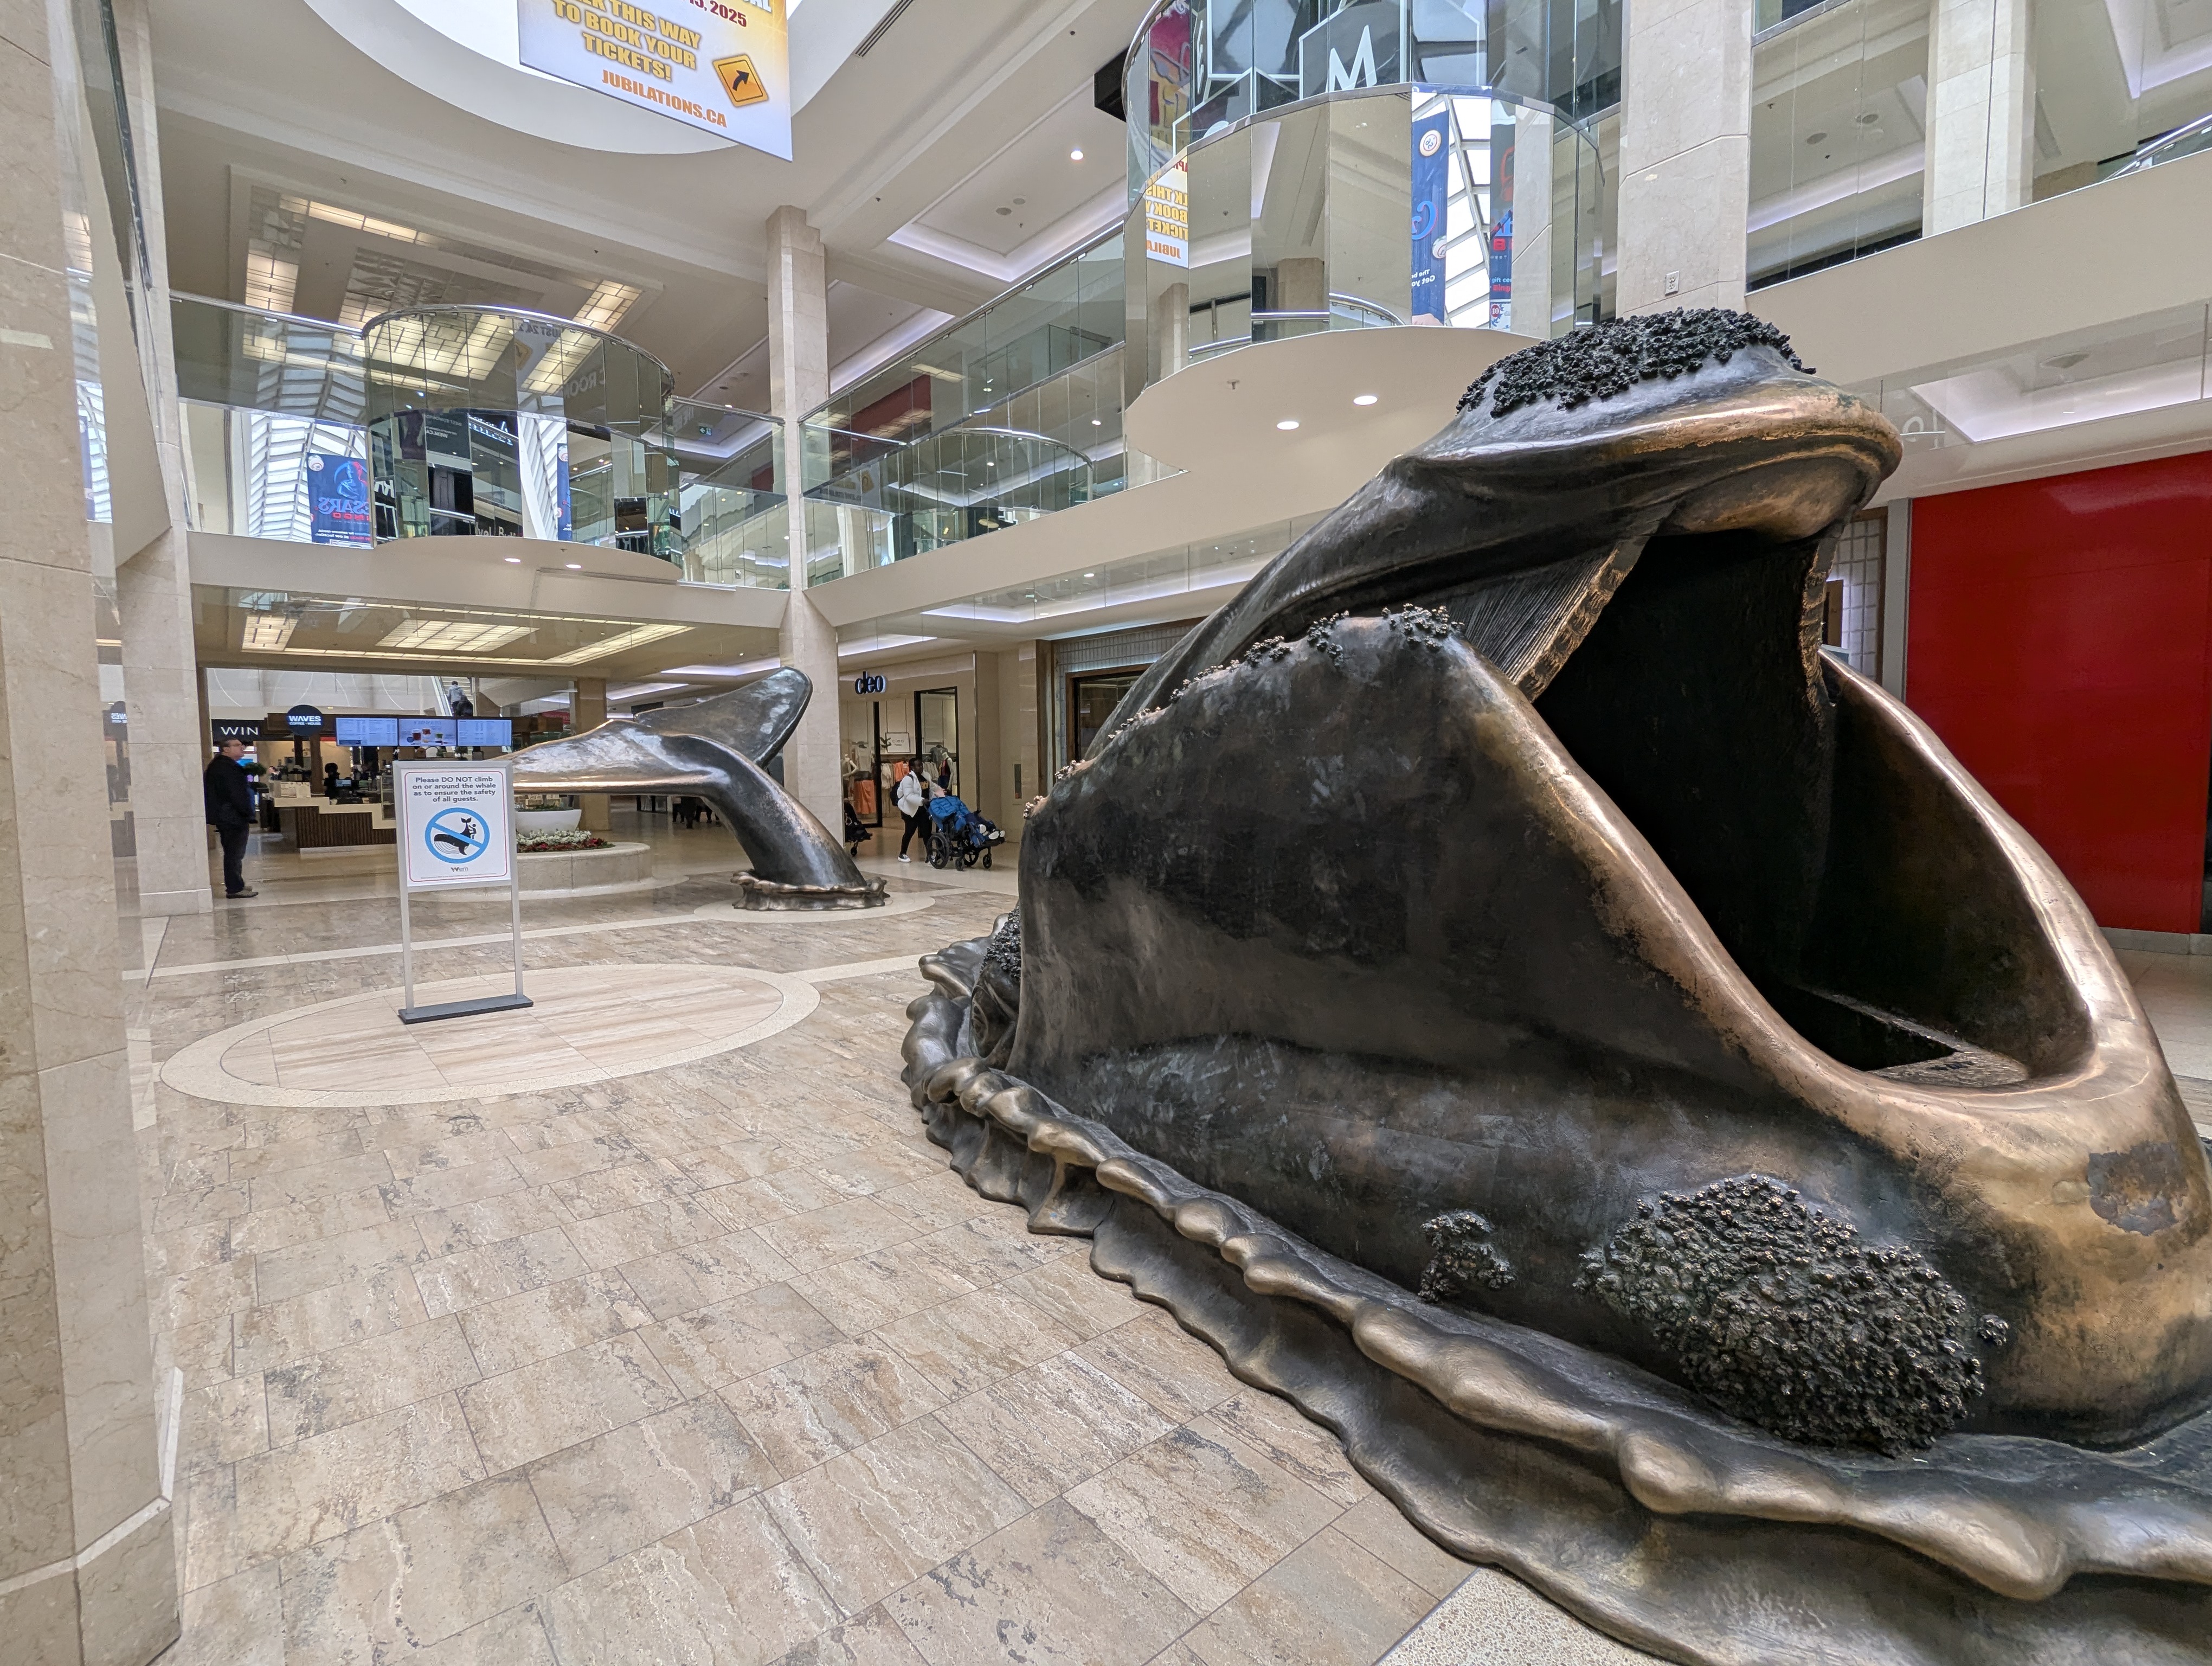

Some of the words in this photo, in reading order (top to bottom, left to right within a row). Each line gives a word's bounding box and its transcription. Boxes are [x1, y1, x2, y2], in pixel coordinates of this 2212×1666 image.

[554, 1, 581, 23] TO
[585, 10, 642, 48] BOOK
[645, 34, 696, 69] YOUR
[609, 0, 655, 31] THIS
[660, 17, 701, 49] WAY
[710, 0, 747, 27] 2025
[583, 33, 671, 81] TICKETS!
[602, 69, 727, 128] JUBILATIONS.CA
[855, 671, 885, 694] cleo
[221, 727, 259, 735] WIN
